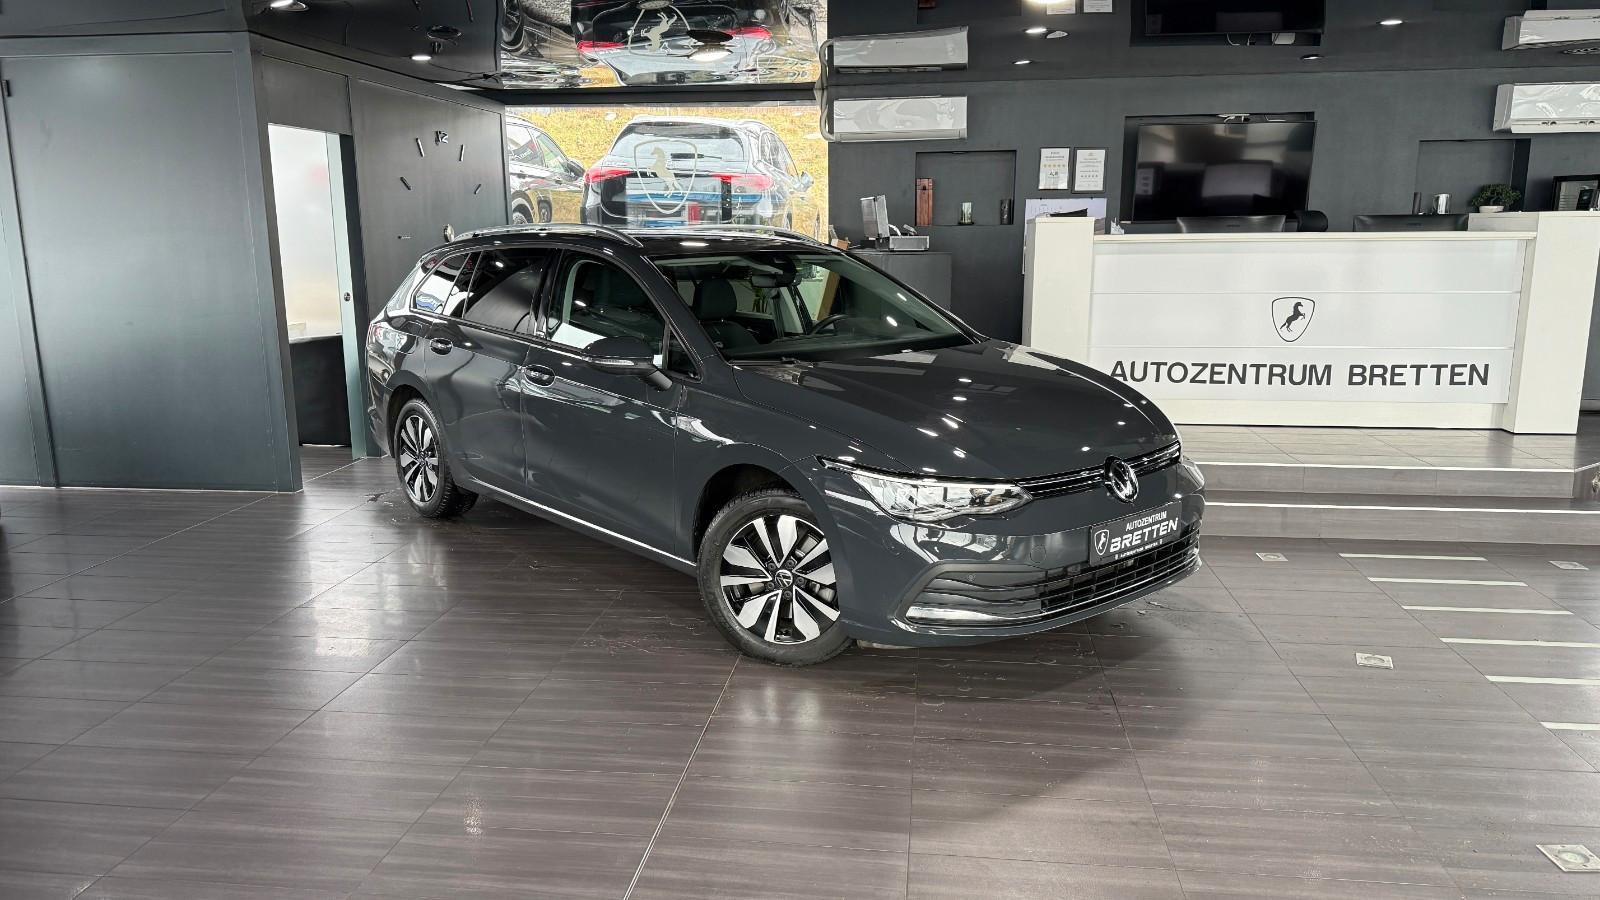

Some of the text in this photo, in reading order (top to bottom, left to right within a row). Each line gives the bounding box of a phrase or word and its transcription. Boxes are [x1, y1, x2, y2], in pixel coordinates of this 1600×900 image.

[1110, 360, 1490, 386] AUTOZENTRUM BRETTEN
[1126, 511, 1167, 531] AUTOZENTRUM
[1110, 517, 1178, 552] BRETTEN
